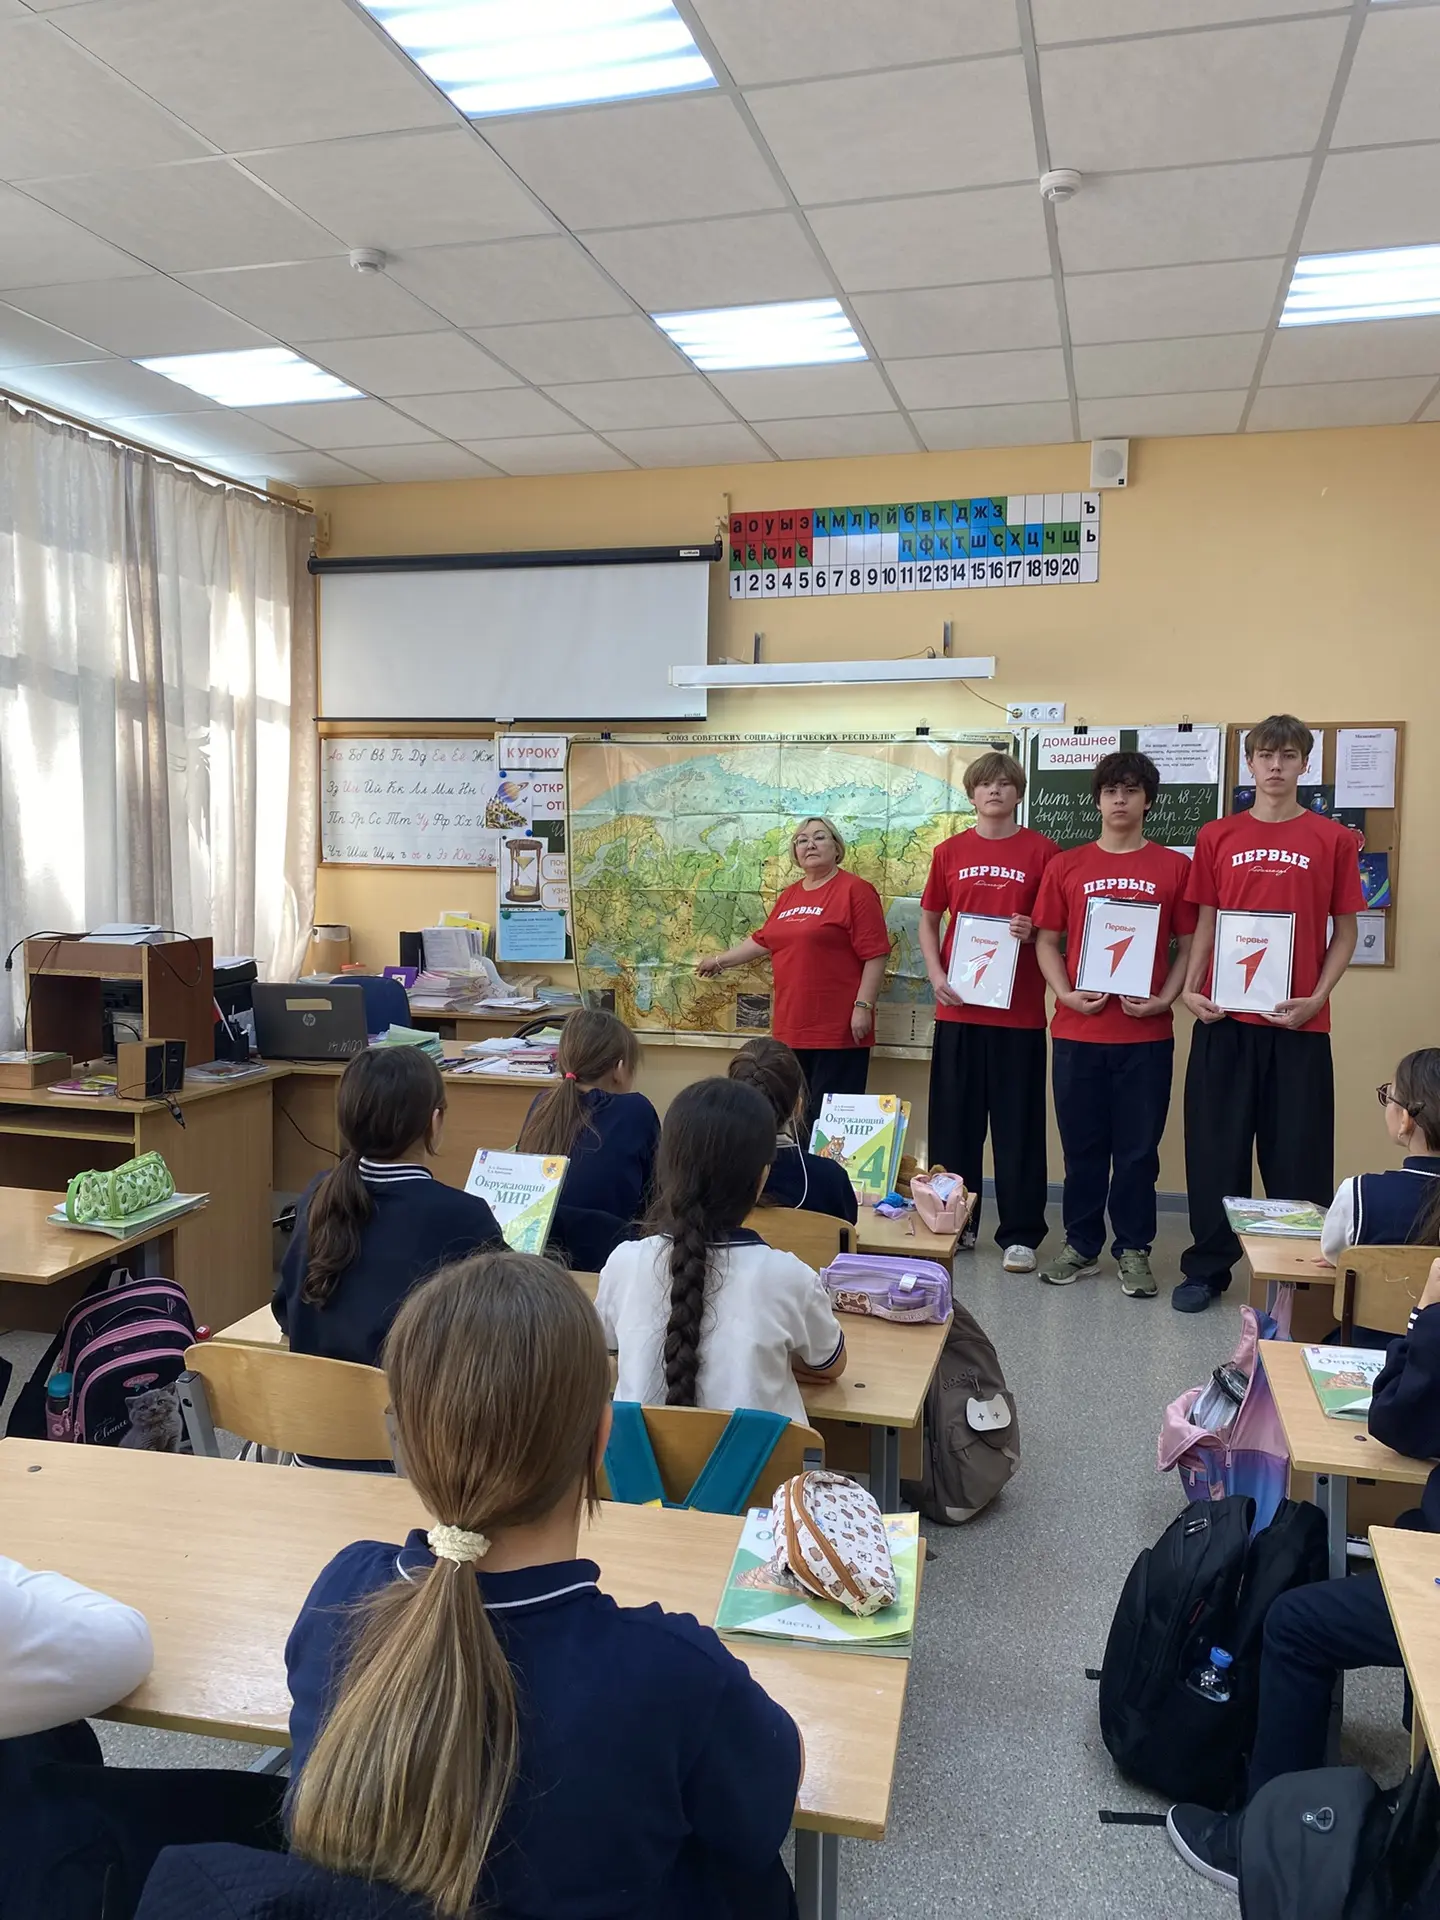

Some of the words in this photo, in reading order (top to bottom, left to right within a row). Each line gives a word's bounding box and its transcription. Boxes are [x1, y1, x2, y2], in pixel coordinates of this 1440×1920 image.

[733, 521, 742, 533] а
[749, 520, 758, 532] о
[765, 519, 774, 535] у
[781, 518, 793, 530] ы
[800, 517, 809, 529] э
[816, 516, 825, 528] н
[833, 515, 845, 527] м
[852, 514, 862, 526] л
[870, 512, 879, 529] р
[887, 508, 896, 524] й
[904, 505, 914, 523] б
[922, 510, 931, 522] в
[938, 508, 946, 520] г
[956, 506, 968, 523] д
[974, 506, 988, 519] ж
[993, 505, 1002, 517] з
[1084, 501, 1096, 514] ъ
[733, 550, 741, 561] я
[748, 544, 756, 560] ё
[764, 548, 777, 560] ю
[782, 547, 792, 559] и
[798, 546, 808, 558] е
[902, 540, 912, 552] п
[919, 534, 934, 555] ф
[940, 537, 949, 550] к
[955, 535, 964, 548] т
[972, 534, 986, 547] ш
[994, 533, 1004, 547] с
[1010, 533, 1020, 546] х
[1028, 532, 1039, 547] ц
[1046, 531, 1055, 544] ч
[1063, 529, 1079, 546] щ
[1086, 529, 1096, 542] ь
[734, 576, 740, 591] 1
[749, 574, 759, 590] 2
[765, 574, 776, 590] 3
[782, 572, 792, 589] 4
[799, 572, 809, 589] 5
[816, 571, 826, 588] 6
[833, 570, 844, 587] 7
[850, 569, 860, 586] 8
[867, 569, 878, 585] 9
[882, 568, 896, 584] 10
[900, 567, 913, 584] 11
[917, 567, 931, 583] 12
[934, 565, 949, 581] 13
[951, 564, 966, 581] 14
[971, 562, 985, 579] 15
[988, 562, 1003, 578] 16
[1006, 561, 1022, 578] 17
[1026, 560, 1041, 577] 18
[1044, 558, 1058, 576] 19
[1062, 558, 1079, 576] 20
[1042, 736, 1116, 748] домашнее
[507, 748, 514, 758] К
[518, 748, 560, 758] УРОКУ
[1050, 753, 1107, 764] задание
[534, 784, 564, 793] ОТКР
[1032, 788, 1074, 806] Лит.
[1178, 788, 1212, 804] 18-24
[476, 814, 485, 828] Ц
[1184, 807, 1200, 821] 23
[1231, 849, 1310, 870] ПЕРВЫЕ
[958, 865, 1025, 884] ПЕРВЫЕ
[1083, 878, 1156, 895] ПЕРВЫЕ
[777, 906, 824, 920] ПЕРВЫЕ
[1104, 922, 1136, 934] Первые
[970, 935, 999, 947] Первые
[1235, 935, 1268, 945] Первые
[825, 1113, 884, 1125] Окружающий
[843, 1125, 873, 1135] МИР
[858, 1146, 886, 1188] 4
[474, 1174, 546, 1193] Окружающий
[494, 1190, 531, 1205] МИР
